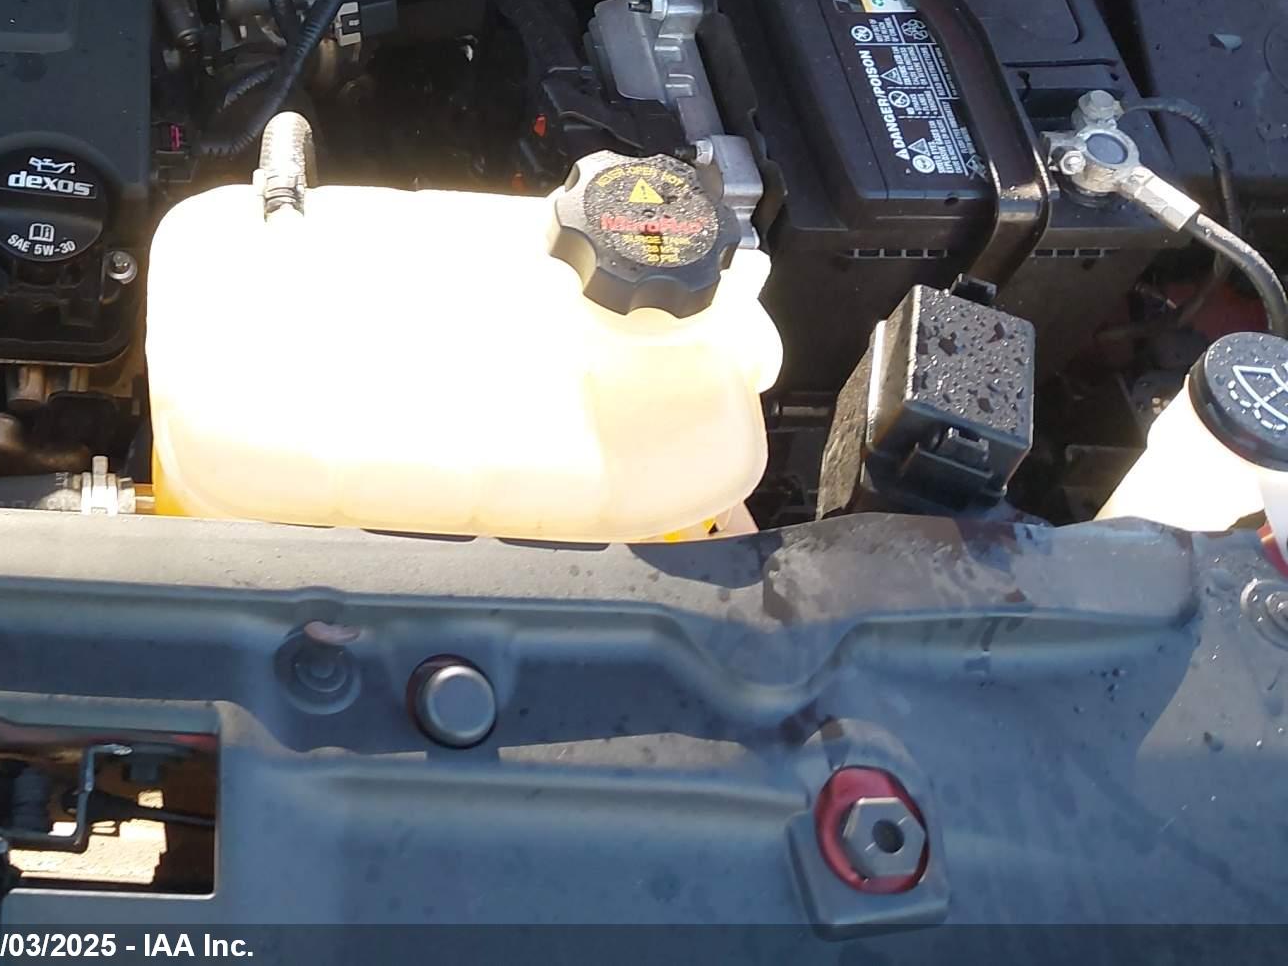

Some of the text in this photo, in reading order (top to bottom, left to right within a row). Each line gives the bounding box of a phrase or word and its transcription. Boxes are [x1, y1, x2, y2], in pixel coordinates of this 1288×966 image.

[858, 50, 906, 148] DANGER/POISON
[627, 165, 657, 177] OPEN
[938, 146, 954, 173] EXPLOSIVE
[7, 170, 94, 196] dexos
[7, 234, 76, 256] SAE 5W-30
[622, 234, 690, 245] SURGE TANK
